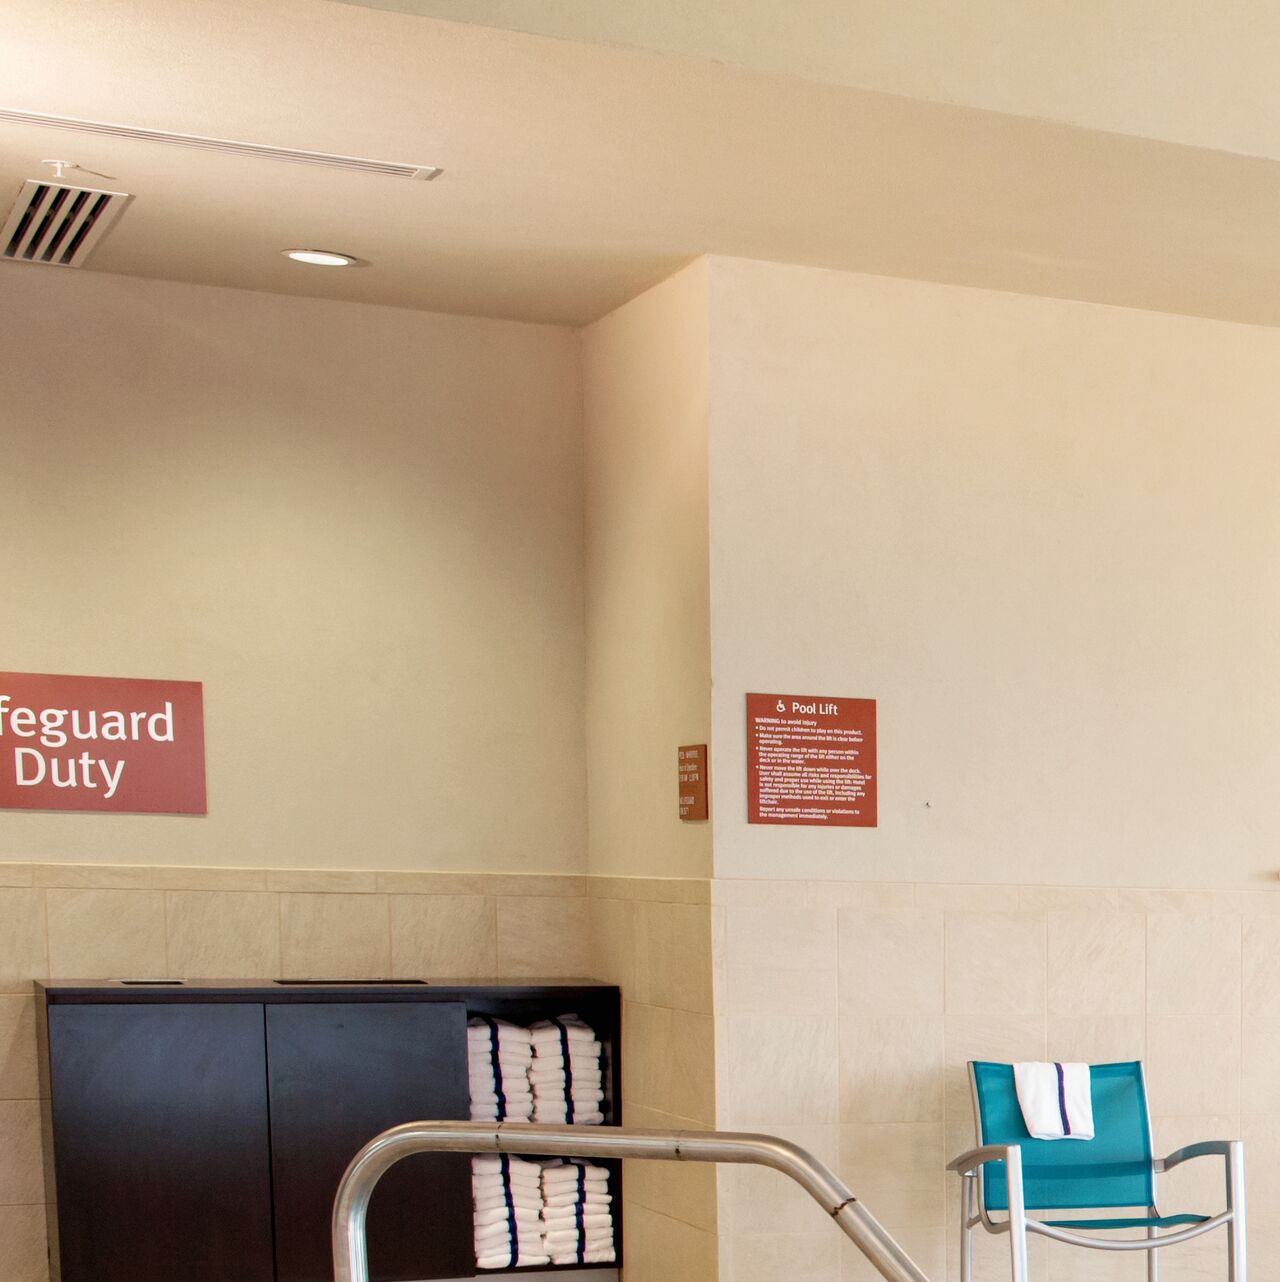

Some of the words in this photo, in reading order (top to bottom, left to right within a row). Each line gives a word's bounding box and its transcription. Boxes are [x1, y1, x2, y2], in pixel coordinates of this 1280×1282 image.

[0, 695, 174, 747] feguard
[792, 702, 816, 714] Pool
[819, 704, 838, 715] Lift
[14, 746, 125, 799] Duty
